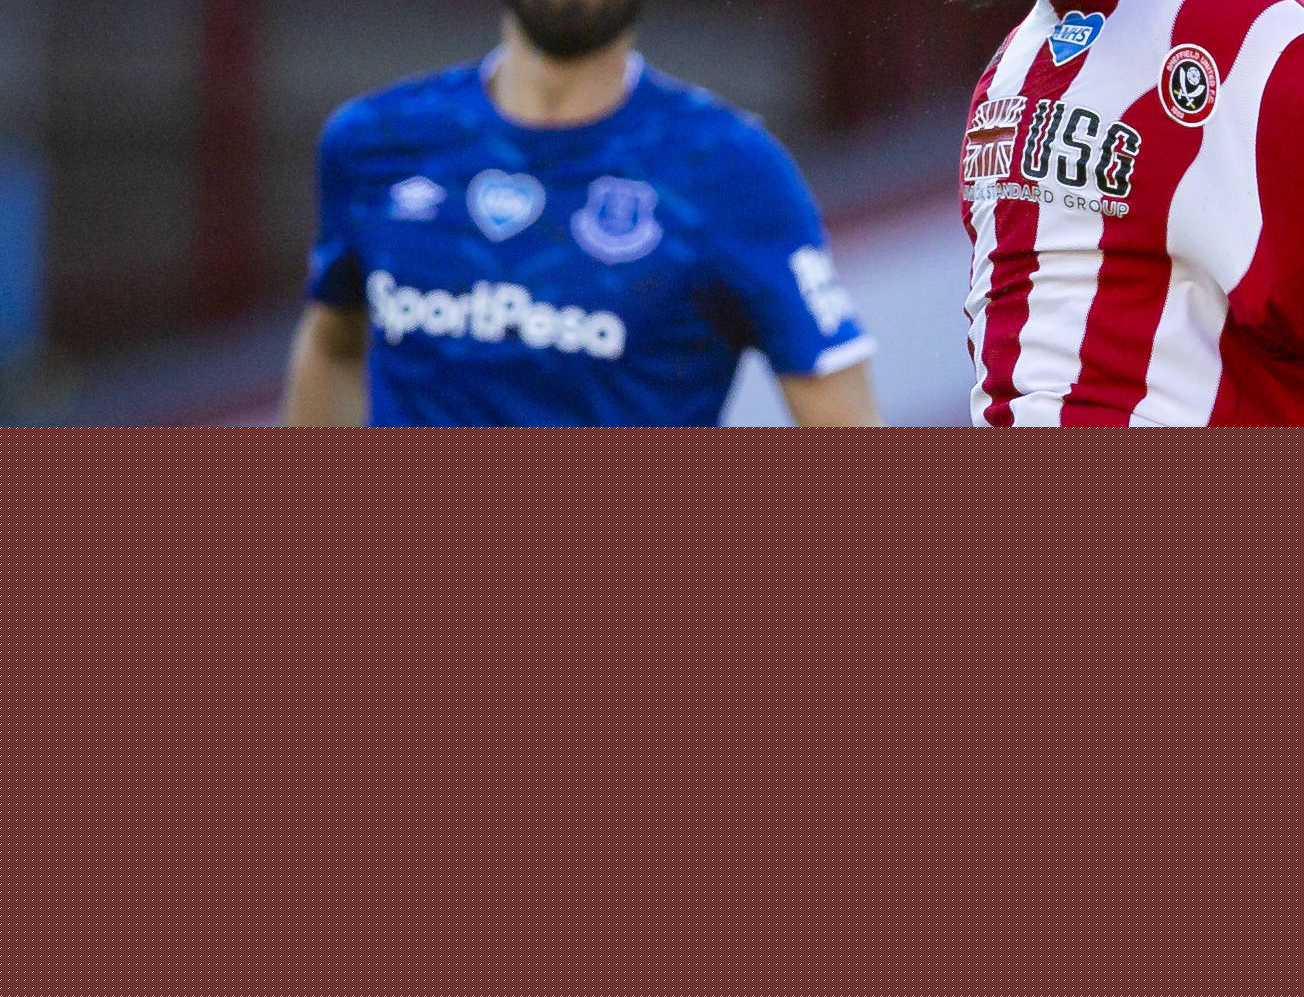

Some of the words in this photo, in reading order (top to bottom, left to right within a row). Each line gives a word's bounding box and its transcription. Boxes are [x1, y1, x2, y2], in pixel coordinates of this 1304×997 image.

[1021, 99, 1142, 198] USG
[1063, 194, 1130, 218] GROUP
[367, 270, 627, 360] SportPesa
